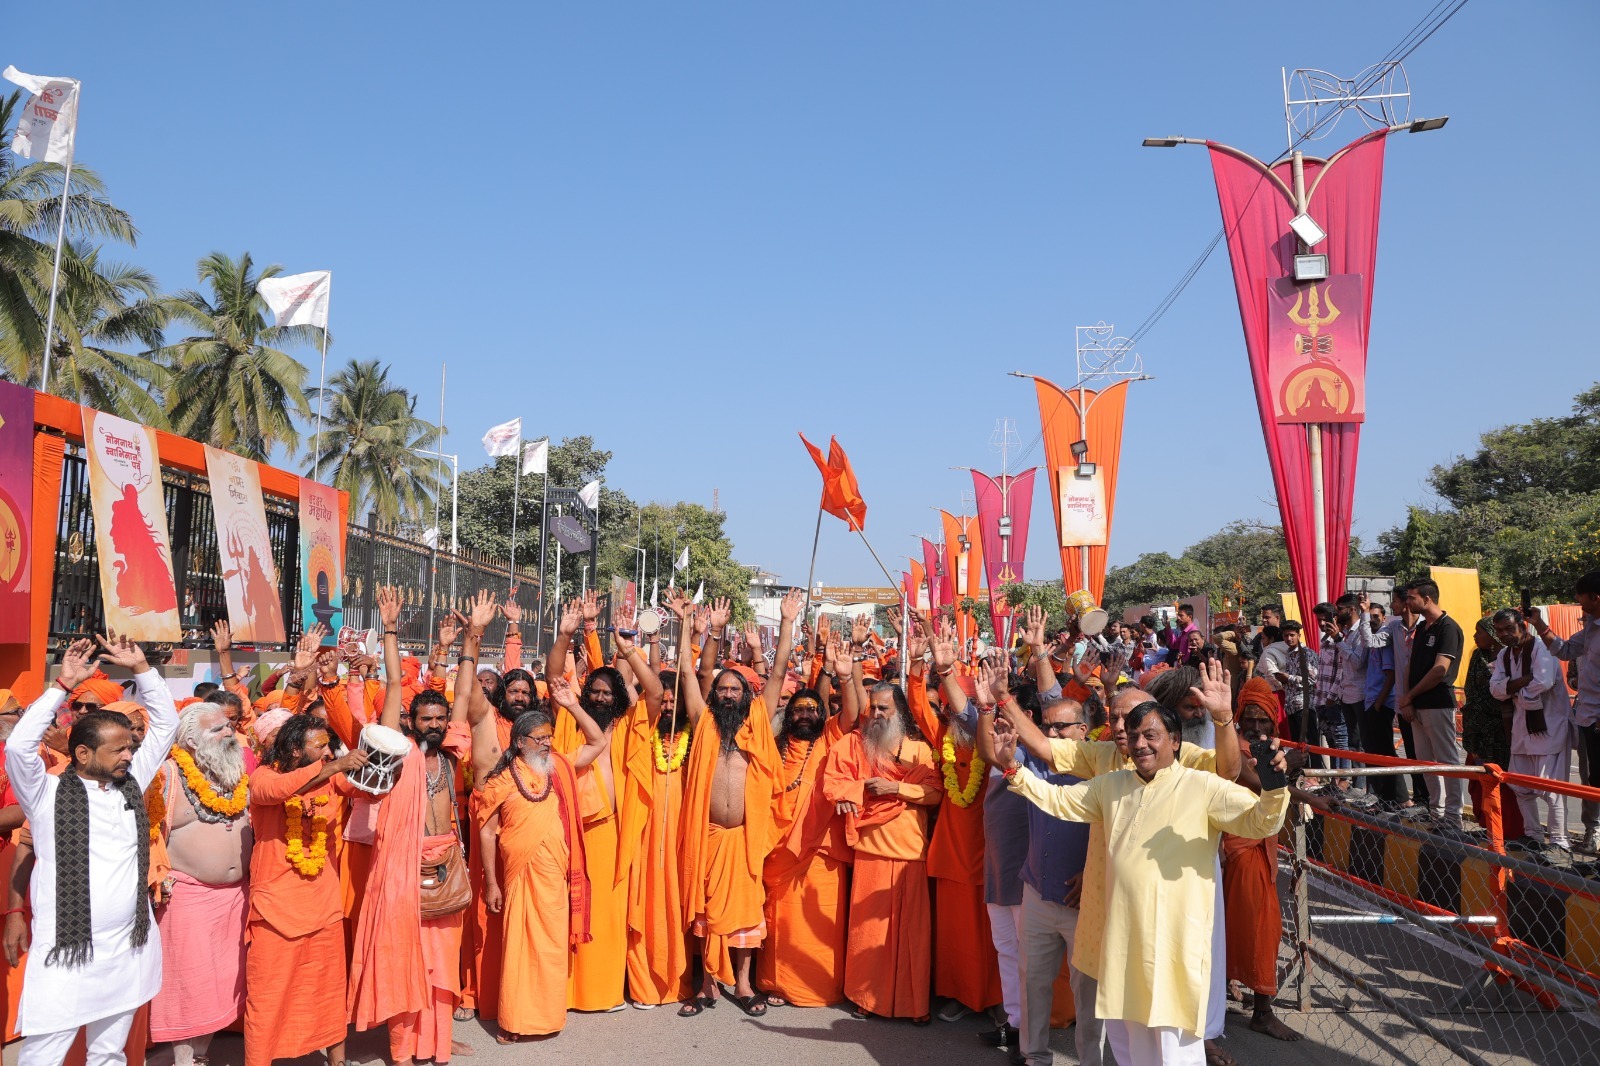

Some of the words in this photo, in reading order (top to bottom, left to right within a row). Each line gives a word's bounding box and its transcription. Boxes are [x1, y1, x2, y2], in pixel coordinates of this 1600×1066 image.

[103, 431, 133, 450] सोमनाथ
[105, 447, 138, 462] स्वाभिमान
[309, 504, 332, 522] महादेव
